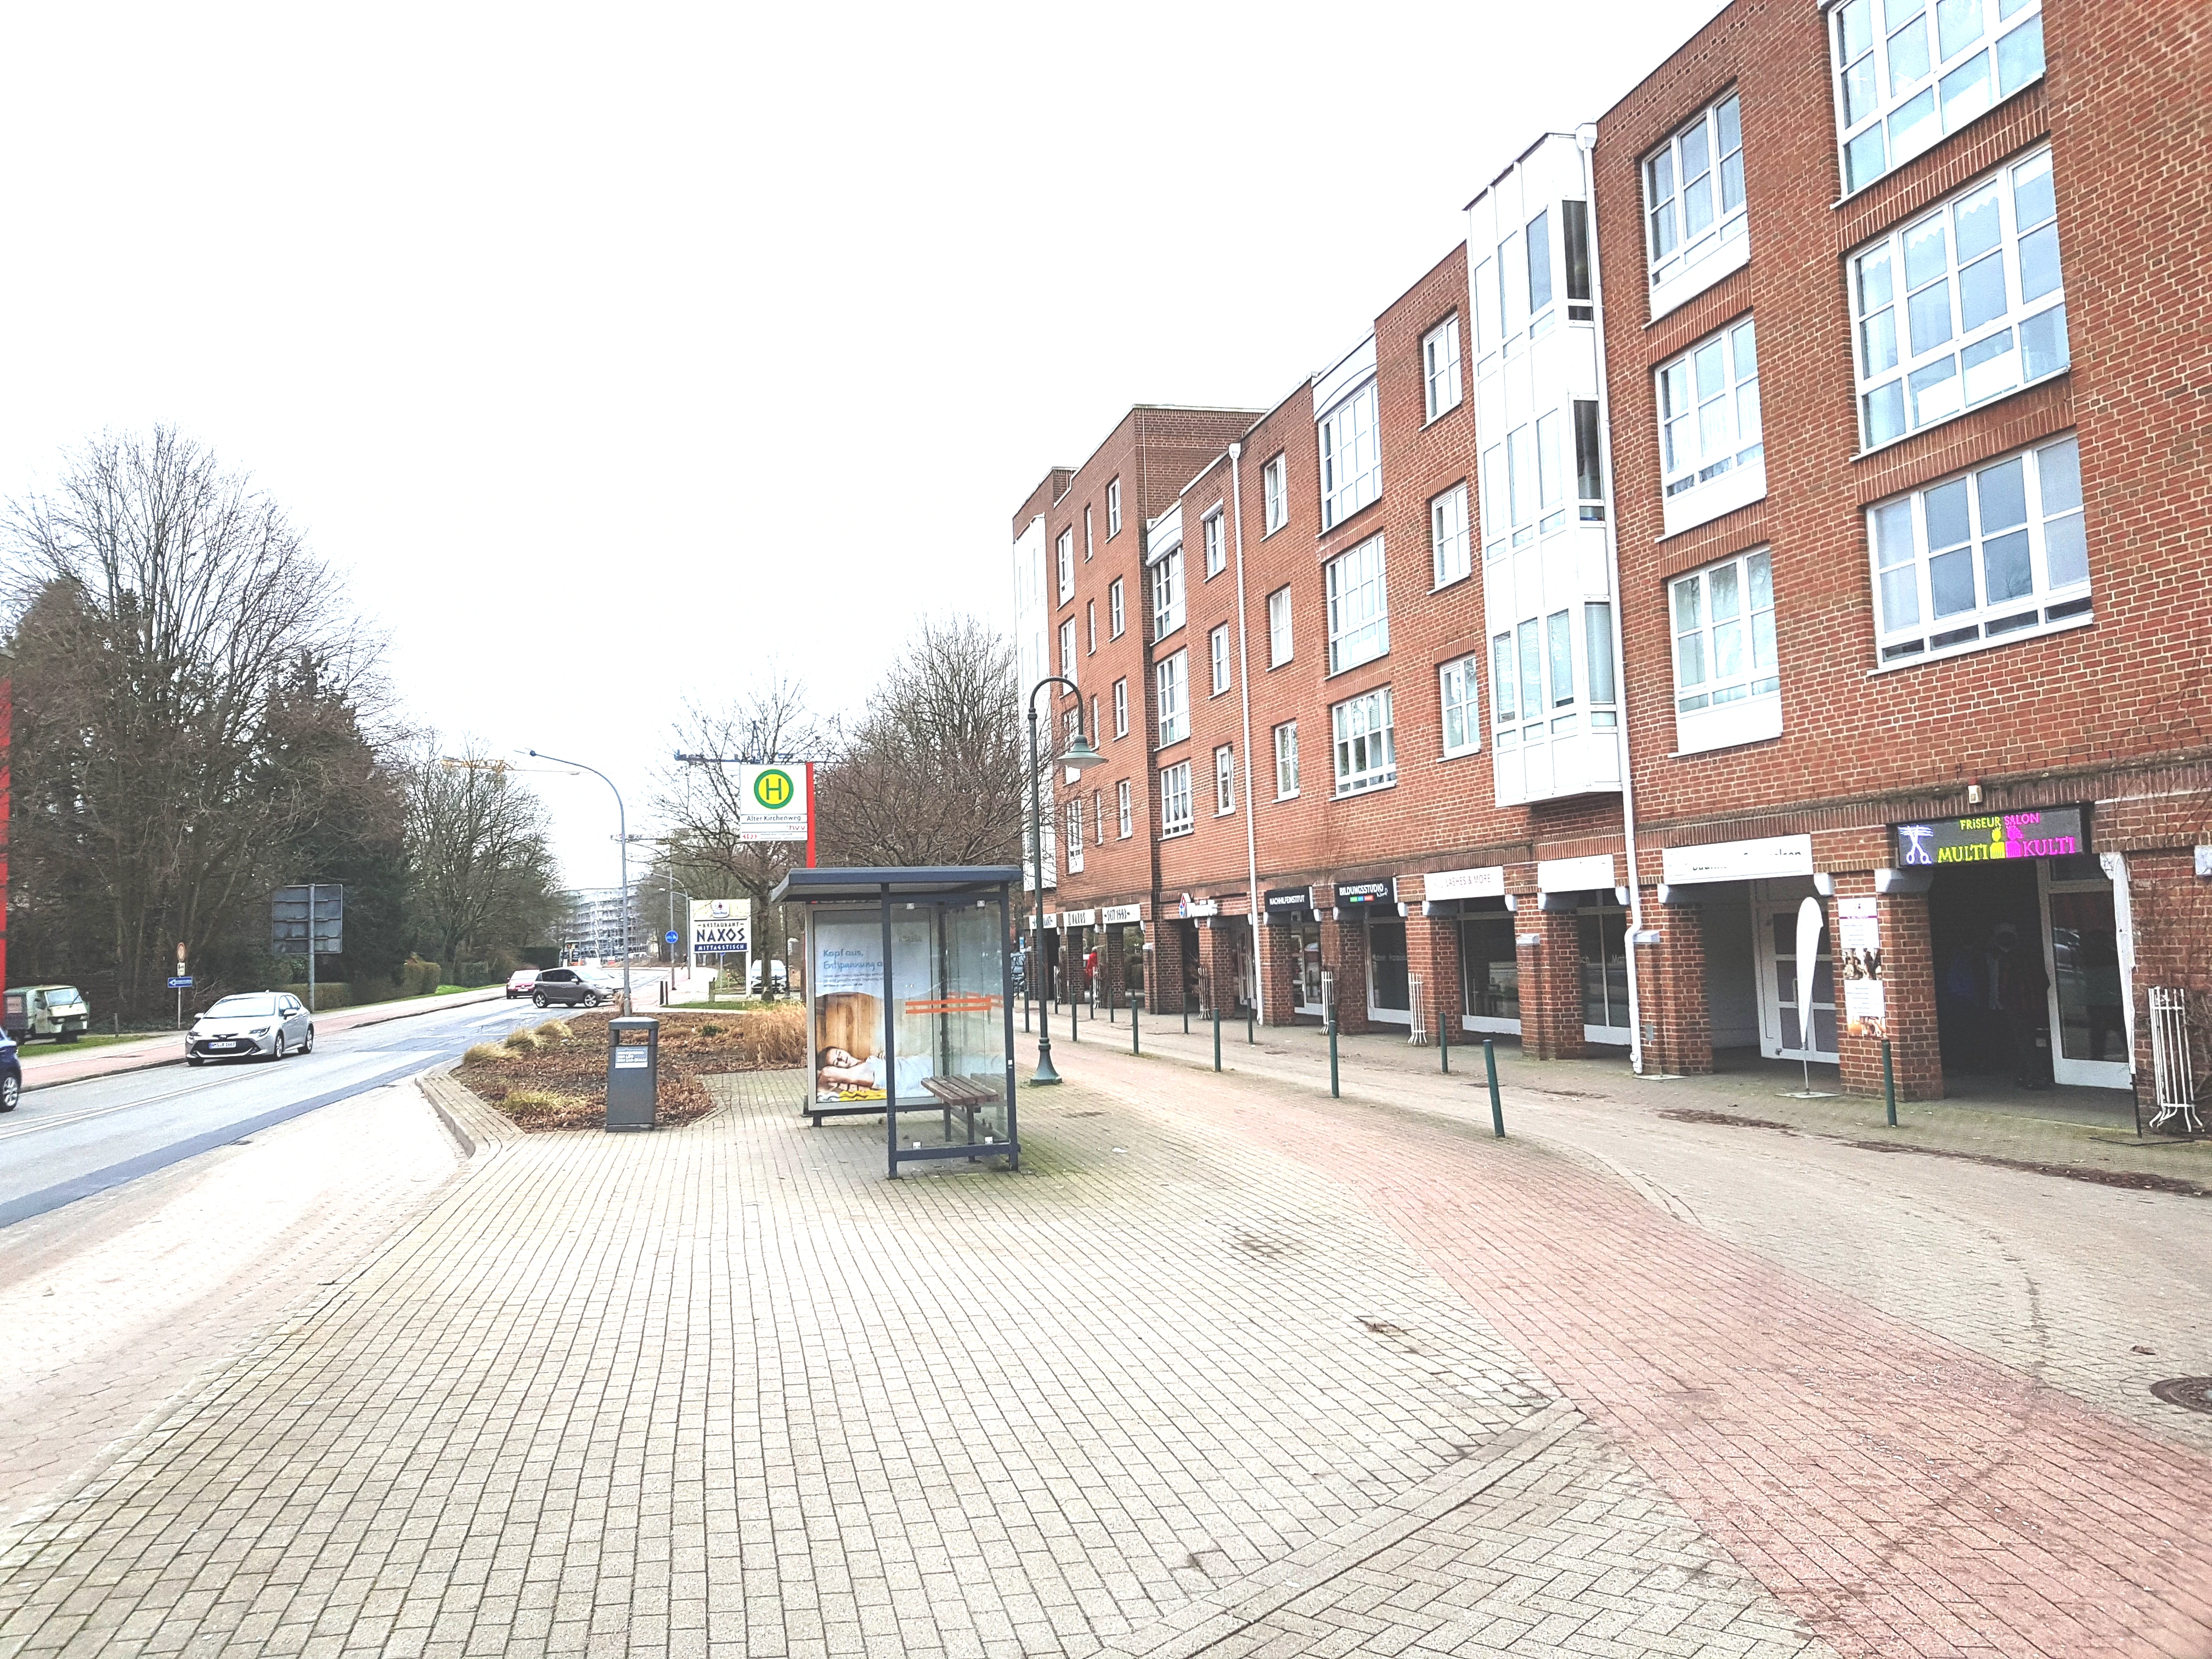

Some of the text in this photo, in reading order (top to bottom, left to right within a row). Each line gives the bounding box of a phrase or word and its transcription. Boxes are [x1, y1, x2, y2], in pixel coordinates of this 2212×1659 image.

[766, 778, 782, 800] H
[2004, 812, 2040, 825] SALON
[1937, 836, 2075, 863] MULTI KULTI
[1445, 876, 1466, 887] LASHES
[1474, 874, 1491, 883] MORE
[1339, 883, 1384, 896] BILDUNGSSTUDIO
[1269, 895, 1305, 905] NACHHILFEINSTITUT
[697, 928, 745, 943] NAXOS
[823, 949, 844, 958] Kopf
